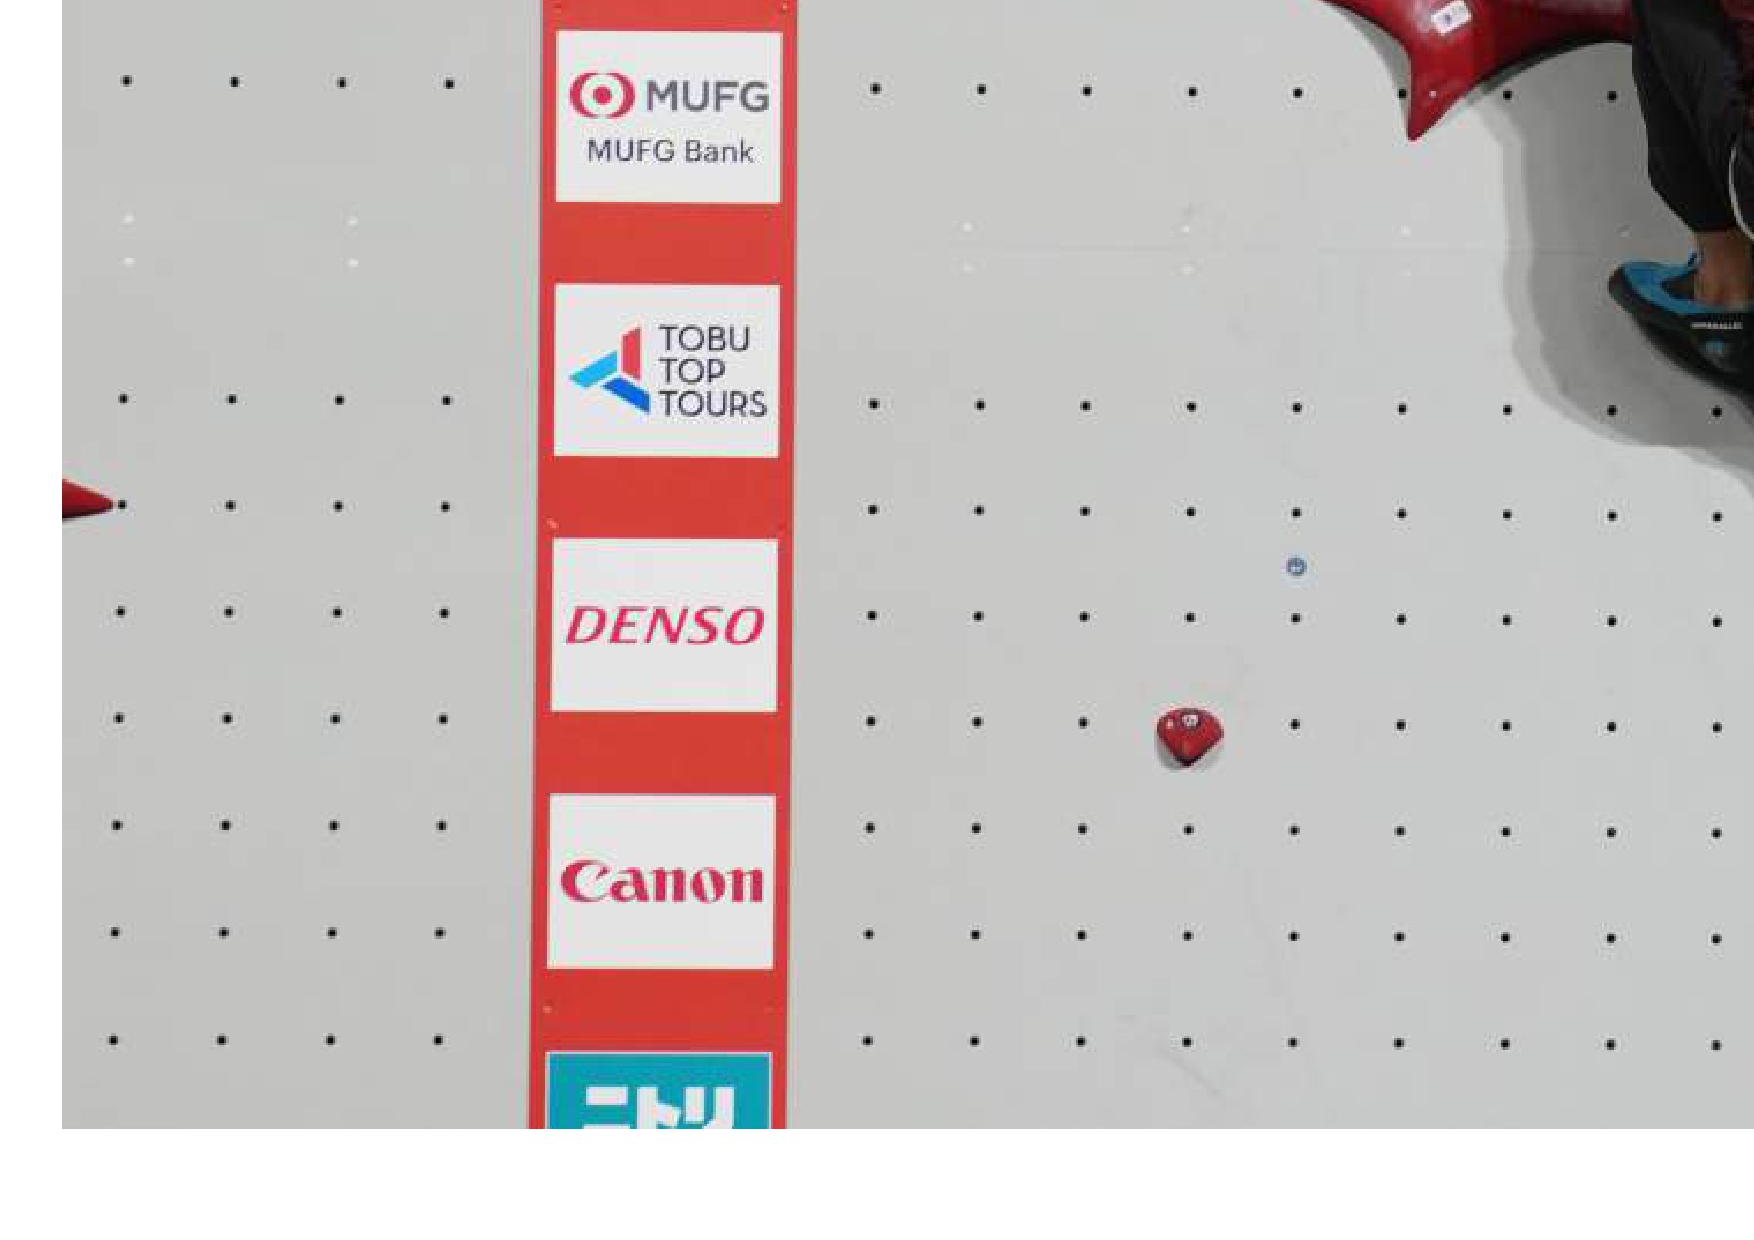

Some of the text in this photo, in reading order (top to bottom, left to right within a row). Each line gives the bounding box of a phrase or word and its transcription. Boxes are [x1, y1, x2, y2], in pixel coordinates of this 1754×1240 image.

[646, 79, 770, 112] MUFG
[588, 137, 754, 162] MUFG Bank
[658, 324, 750, 352] TOBU
[658, 358, 726, 384] TOP
[658, 390, 768, 418] TOURS
[566, 606, 765, 645] DENSO
[560, 860, 764, 903] Canon
